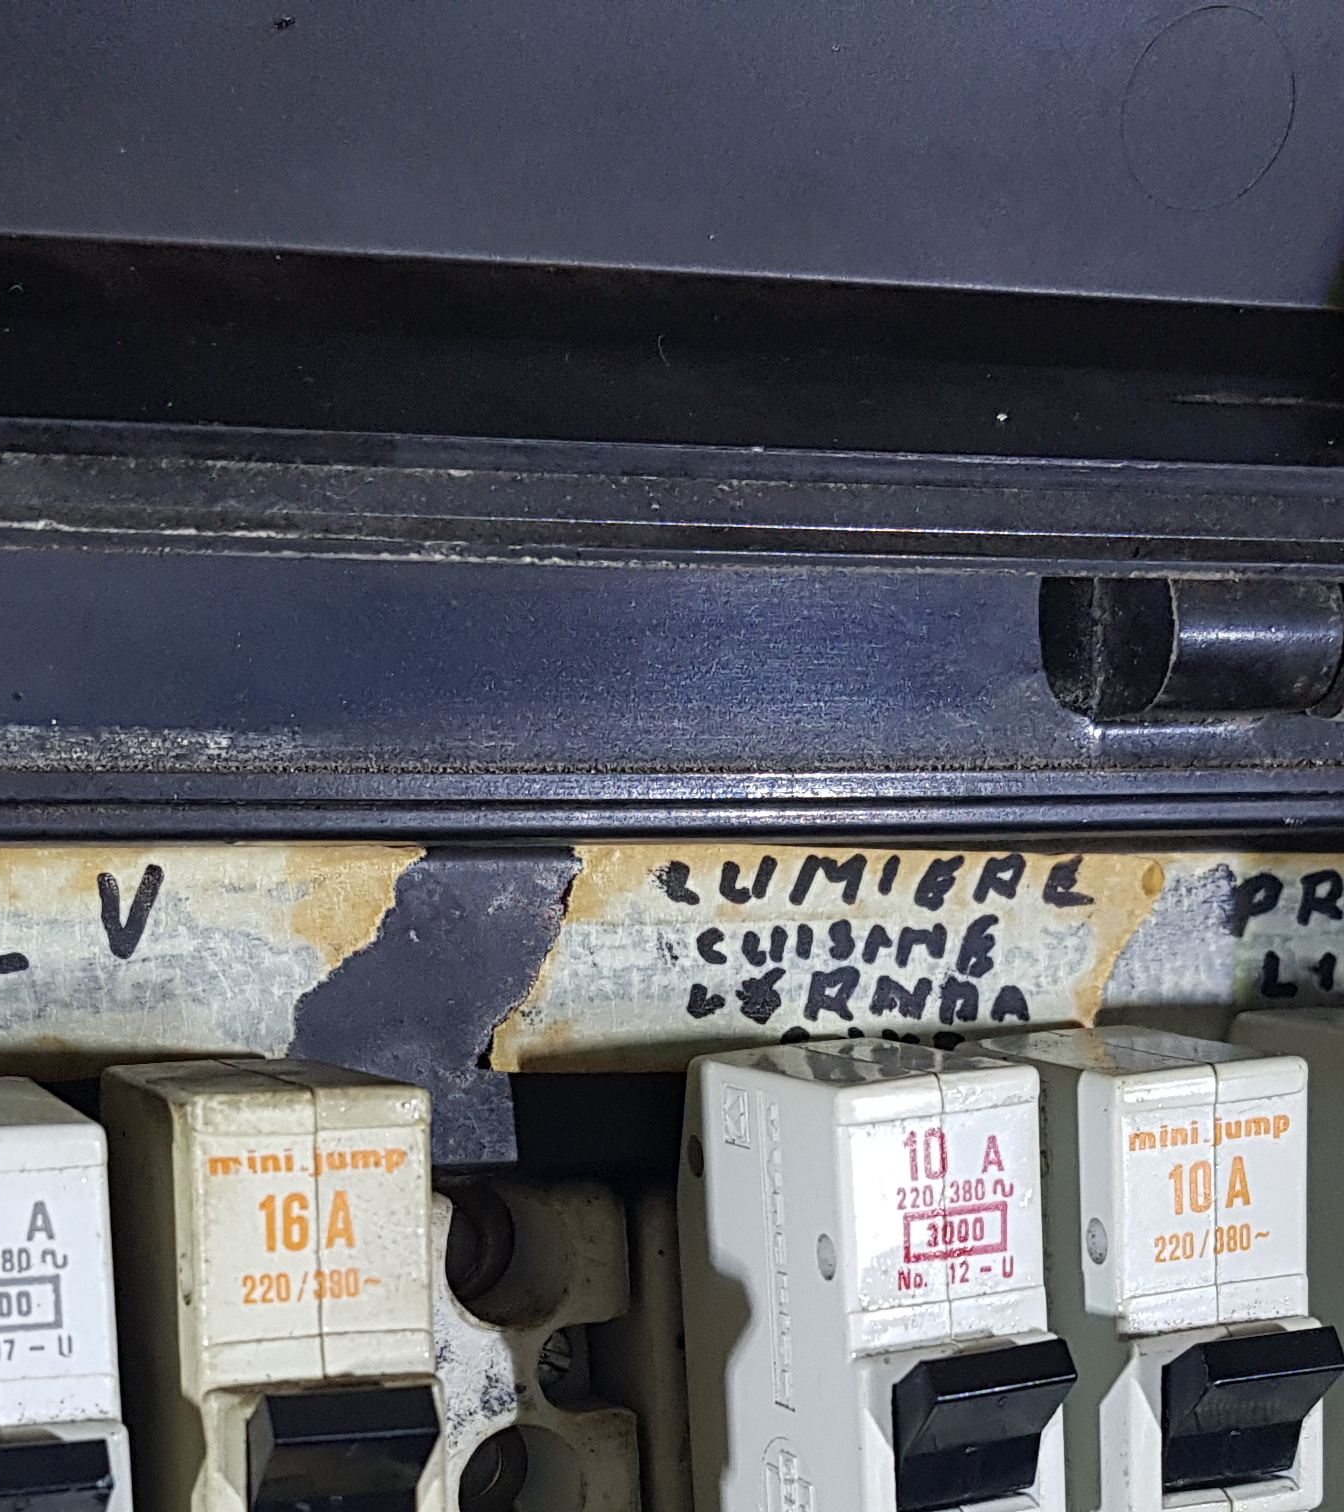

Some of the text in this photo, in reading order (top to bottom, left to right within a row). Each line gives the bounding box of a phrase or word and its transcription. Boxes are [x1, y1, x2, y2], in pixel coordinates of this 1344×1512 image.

[97, 864, 164, 959] V
[902, 1127, 1004, 1181] 10 A
[1169, 1160, 1211, 1215] 10
[27, 1200, 55, 1241] A
[260, 1192, 309, 1252] 16
[927, 1217, 984, 1247] 3000
